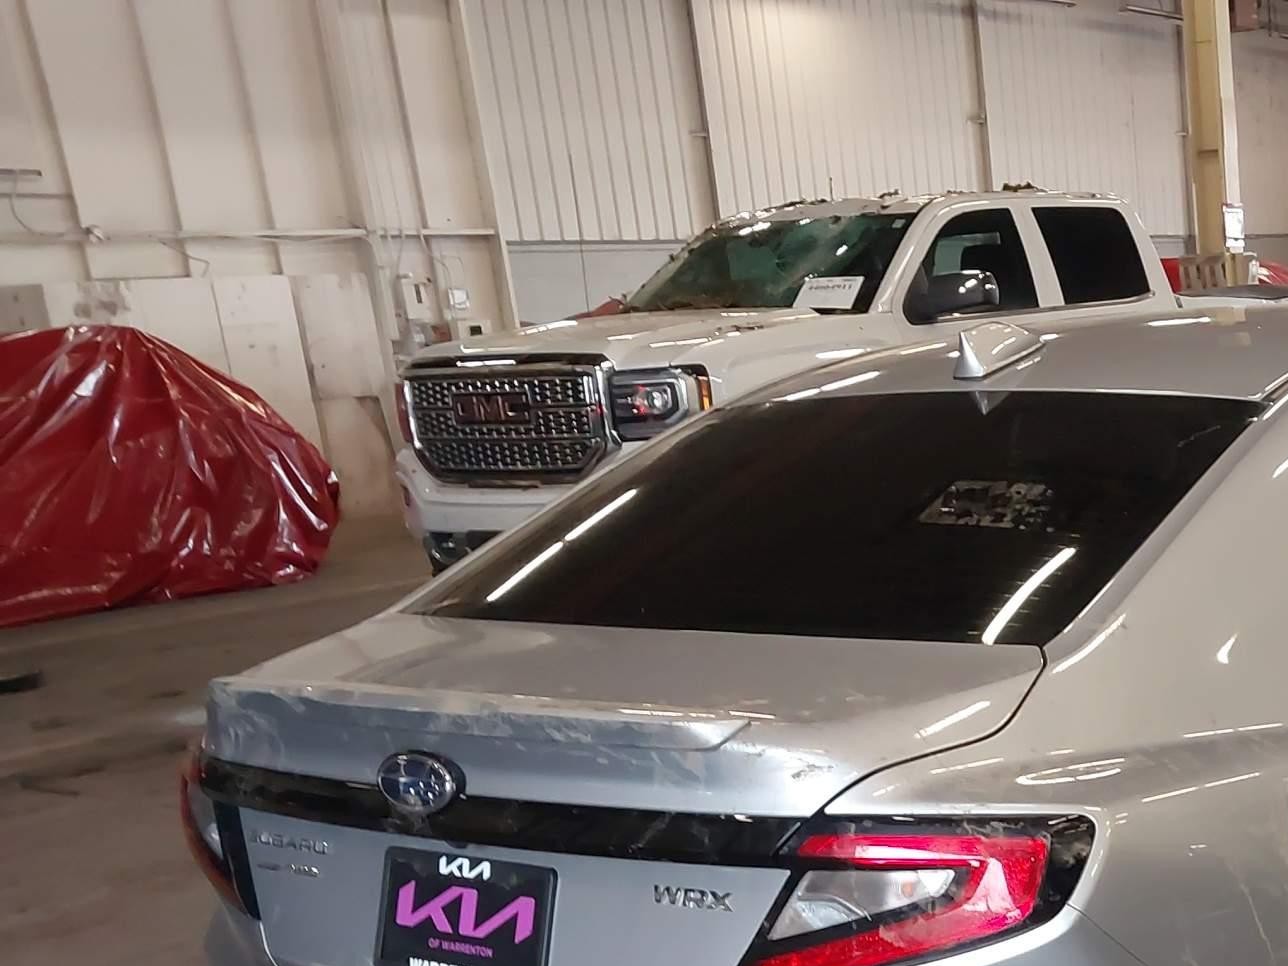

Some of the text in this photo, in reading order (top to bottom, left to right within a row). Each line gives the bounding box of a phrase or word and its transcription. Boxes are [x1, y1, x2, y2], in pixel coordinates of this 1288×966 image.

[455, 394, 529, 421] GMC
[438, 855, 491, 881] KIA
[395, 879, 536, 944] KIA
[653, 884, 734, 913] WRX
[427, 937, 493, 958] OF WARRENTON
